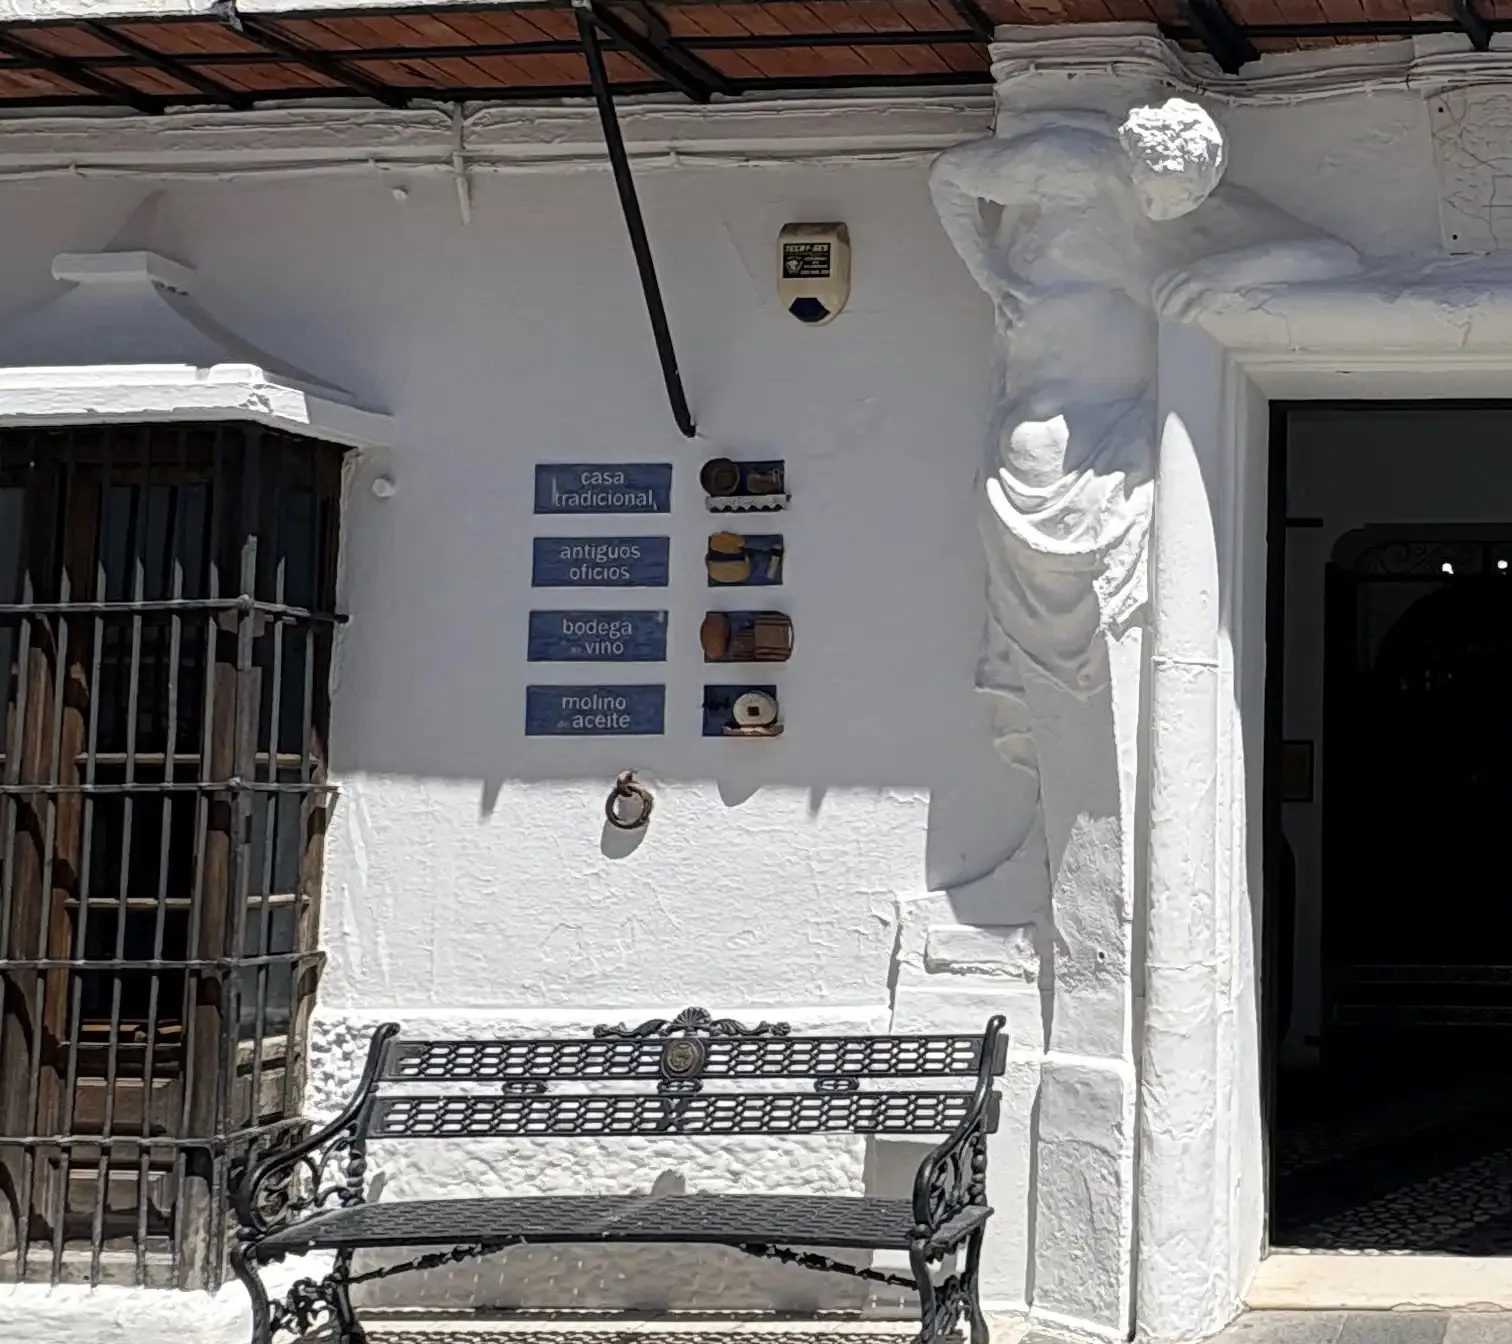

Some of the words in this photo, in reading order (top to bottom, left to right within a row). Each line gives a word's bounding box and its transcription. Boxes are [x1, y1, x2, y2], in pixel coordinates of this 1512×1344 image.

[580, 471, 625, 485] casa
[554, 489, 653, 507] tradicional
[560, 543, 641, 563] antiguos
[569, 564, 630, 580] oficios
[562, 618, 633, 639] bodega
[584, 640, 625, 655] vino
[561, 694, 627, 710] molino
[571, 712, 631, 729] aceite
